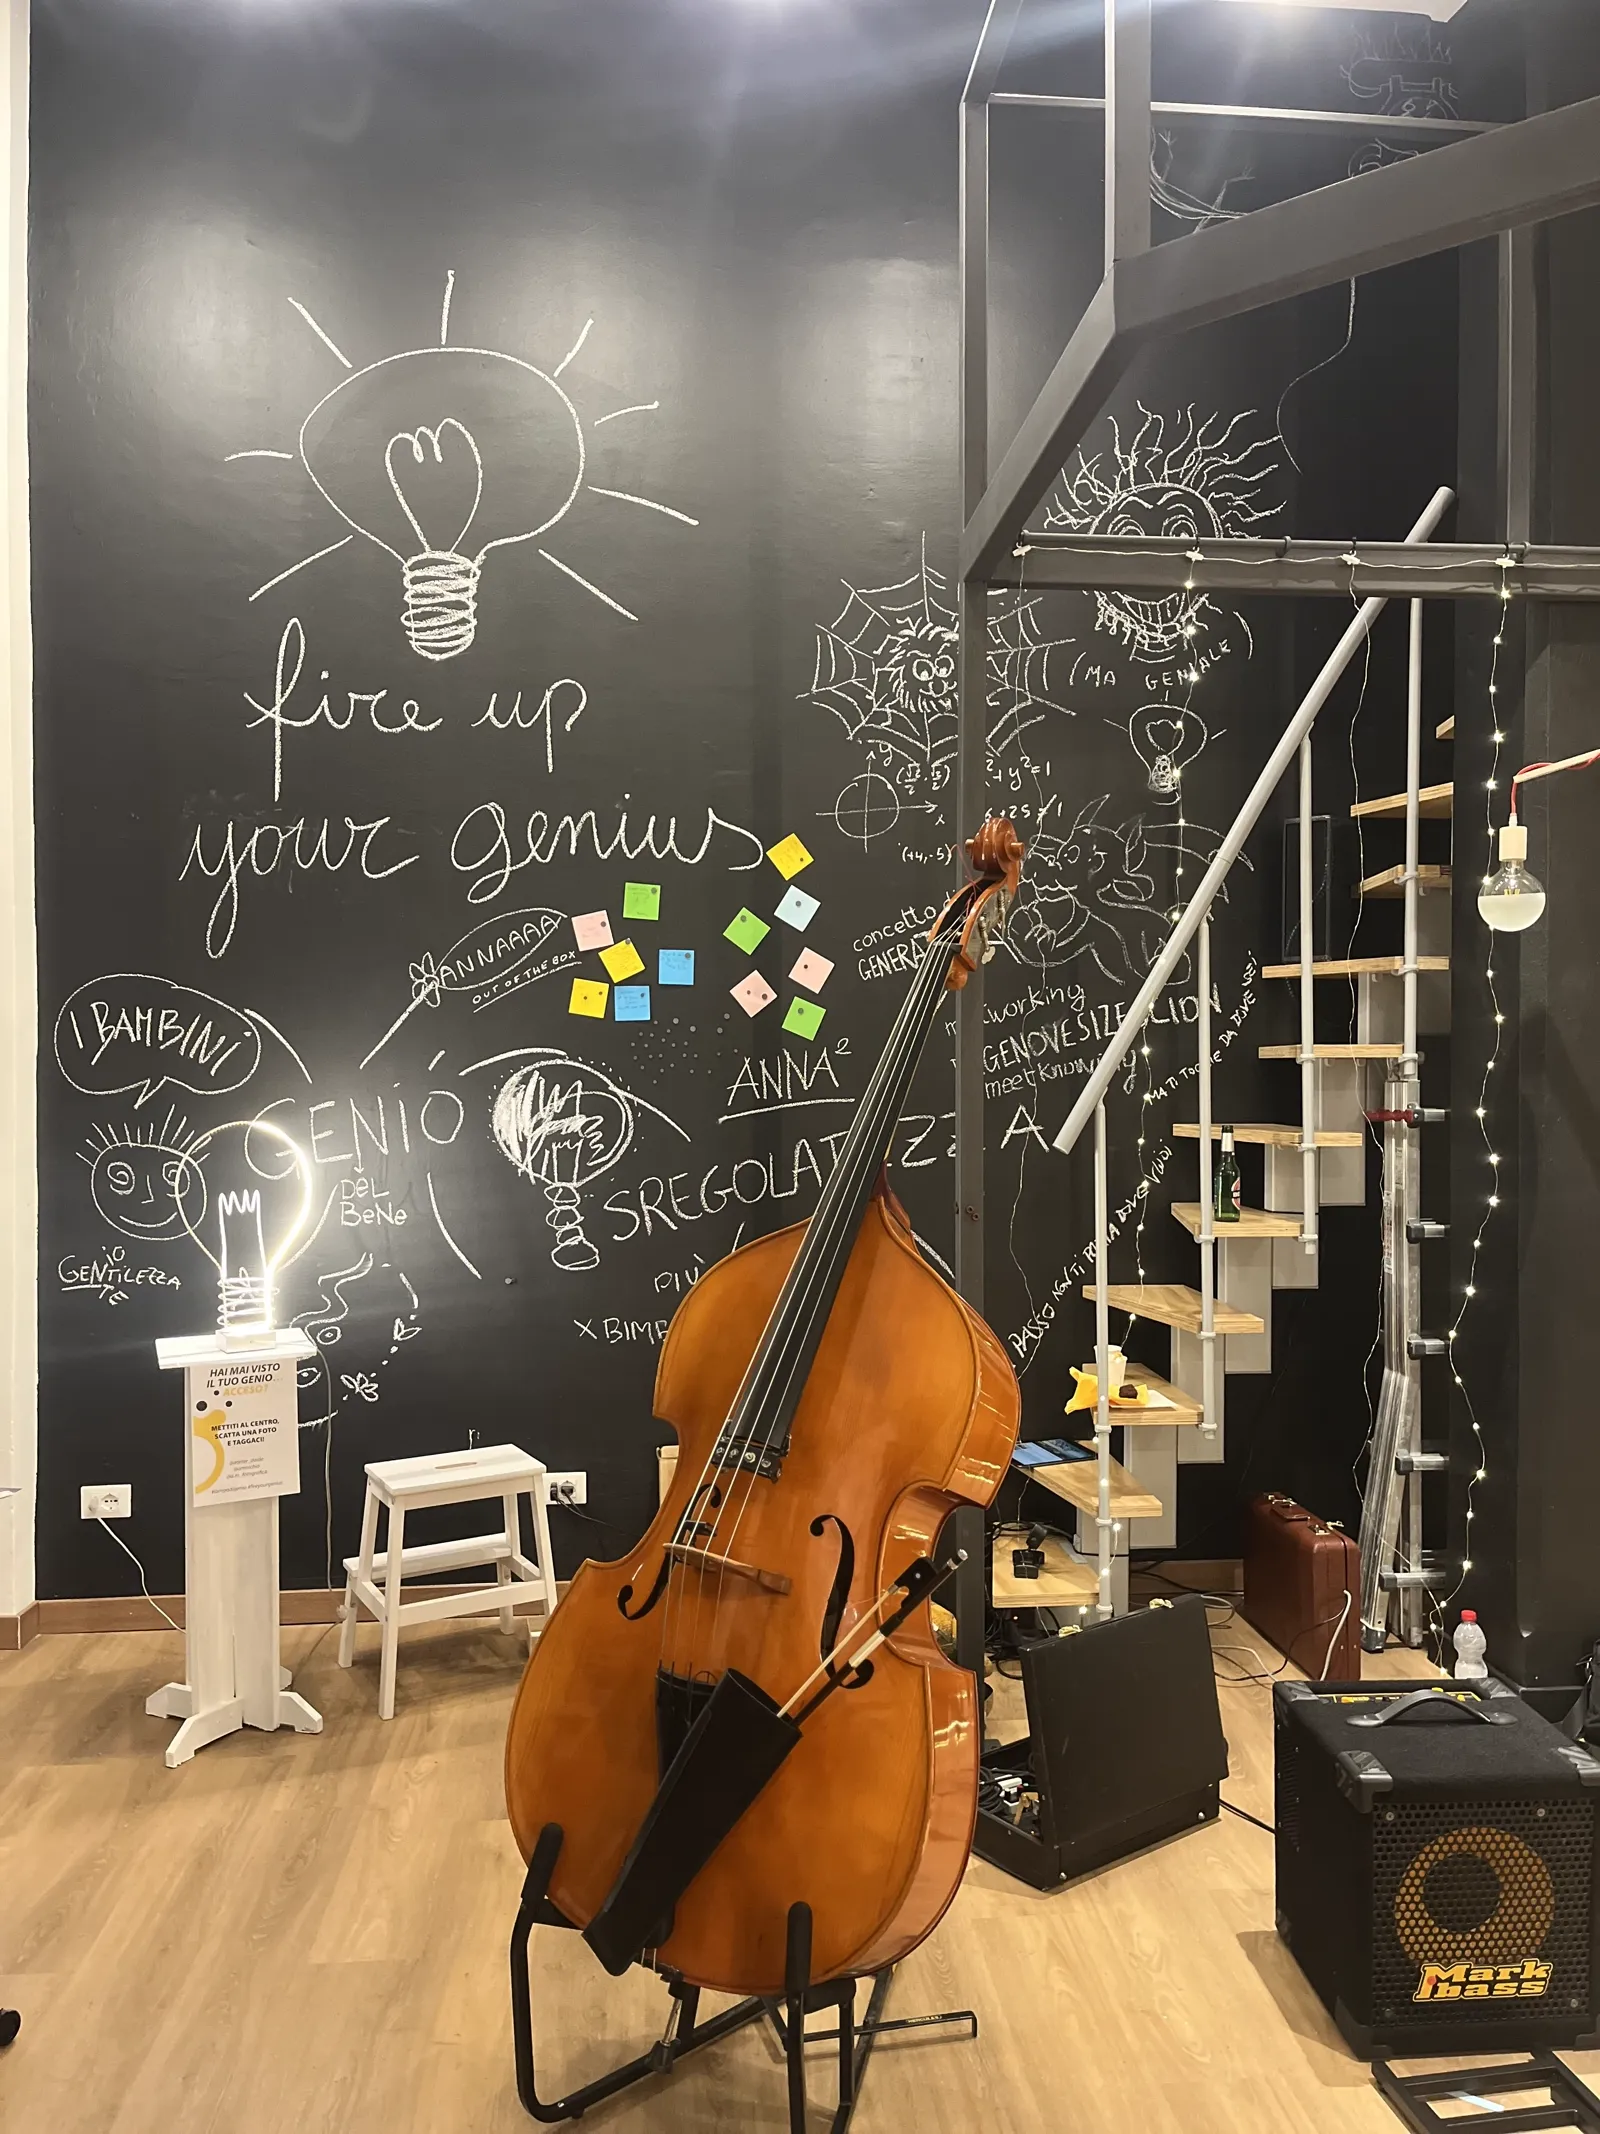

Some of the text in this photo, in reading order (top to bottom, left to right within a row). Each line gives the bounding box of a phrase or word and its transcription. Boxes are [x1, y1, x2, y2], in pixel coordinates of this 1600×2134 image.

[243, 616, 588, 802] fire up
[177, 792, 765, 959] your genius
[853, 904, 937, 952] concetto
[440, 914, 560, 988] ANNAAAA
[472, 950, 577, 1005] OUT OF THE BOX
[1218, 1029, 1239, 1048] DA
[210, 1362, 281, 1378] HAI MAI VISTO
[206, 1379, 216, 1389] IL
[218, 1376, 239, 1387] TUO
[223, 1383, 269, 1397] ACCESO?
[211, 1423, 239, 1432] METTITI
[240, 1421, 249, 1429] AL
[214, 1426, 277, 1440] SCATTA UNA FOTO
[1416, 1960, 1551, 1999] Mark
[1433, 1980, 1547, 1999] bass
